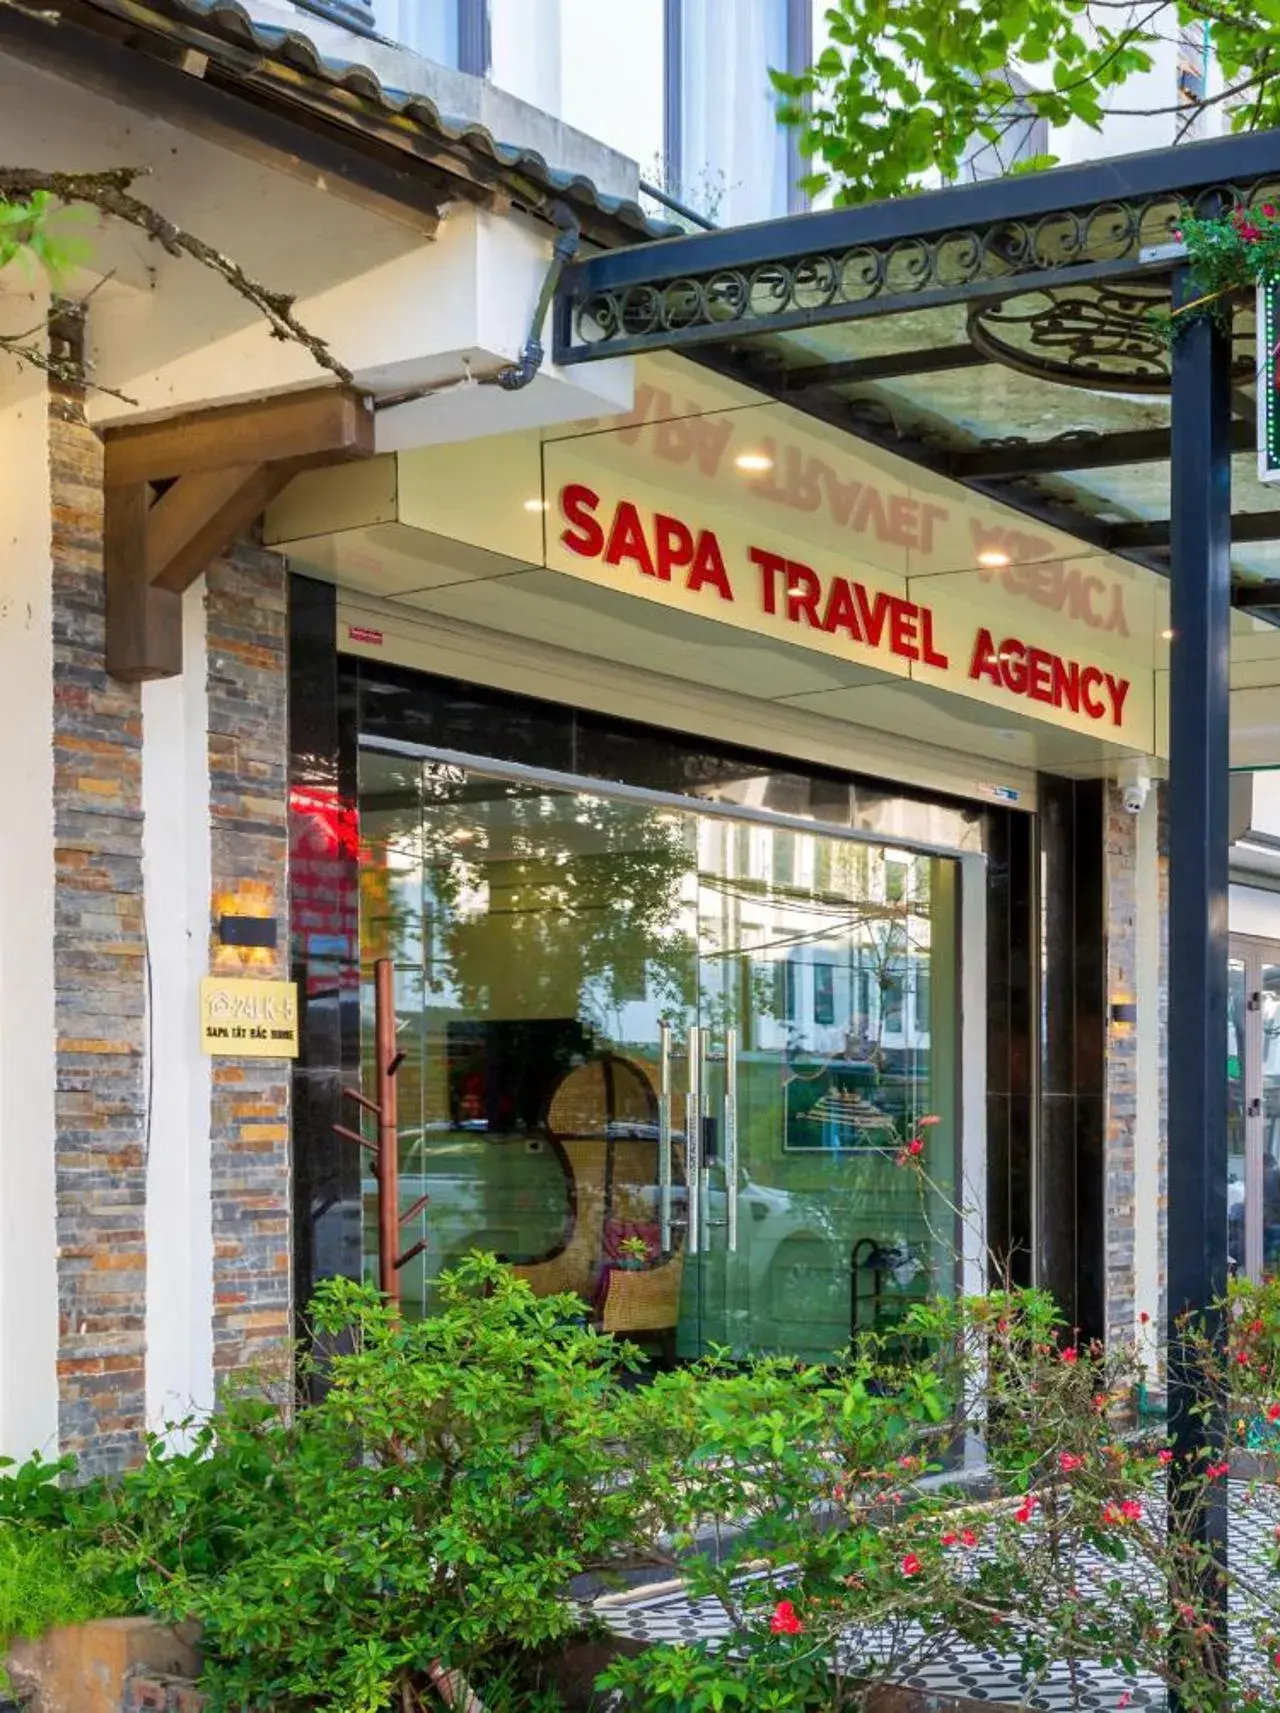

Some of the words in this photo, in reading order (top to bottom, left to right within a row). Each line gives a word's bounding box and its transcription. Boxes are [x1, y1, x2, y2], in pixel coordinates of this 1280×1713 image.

[561, 483, 734, 602] SAPA
[747, 546, 948, 670] TRAVEL
[970, 628, 1130, 726] AGENCY
